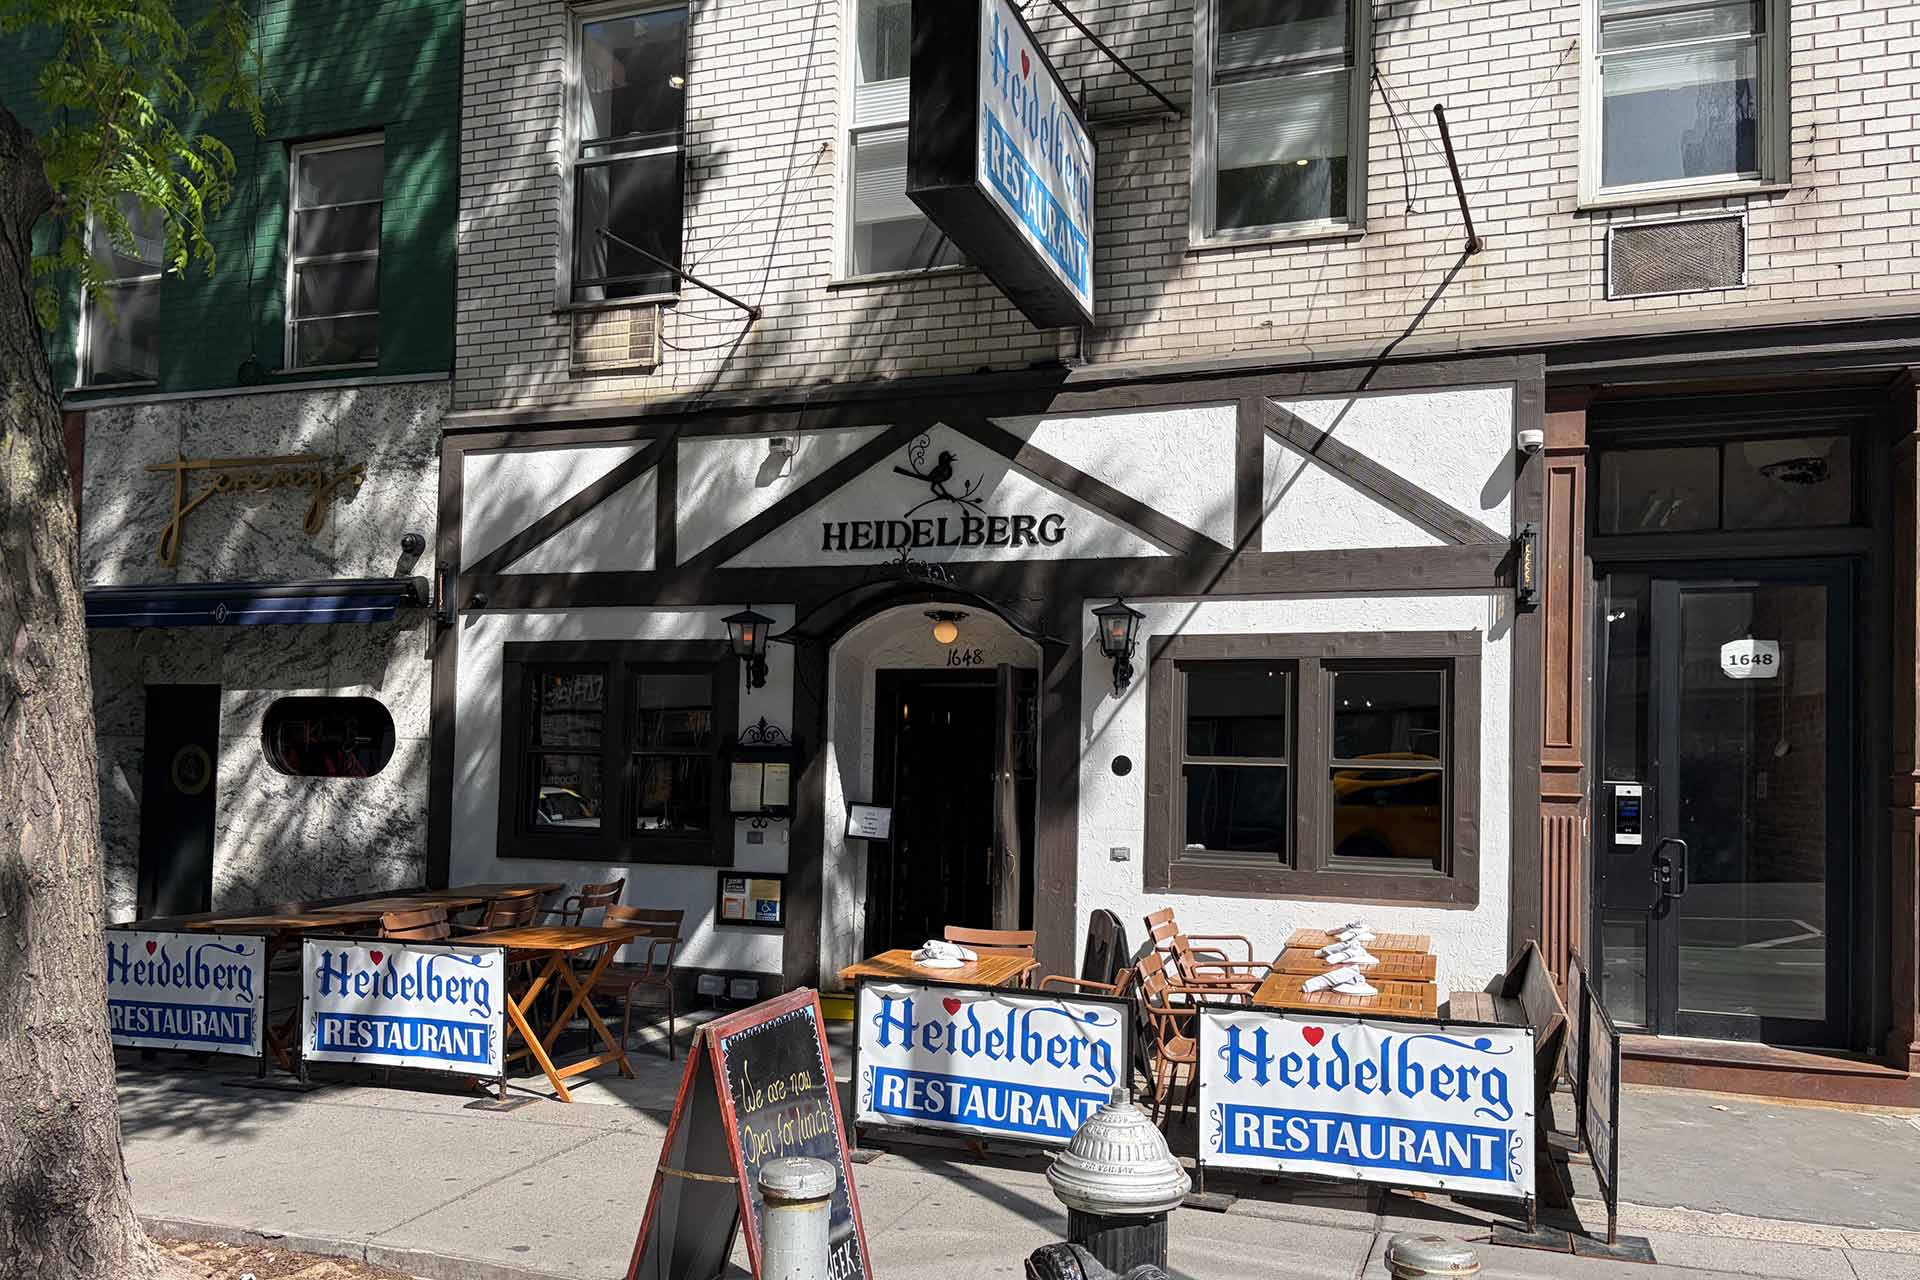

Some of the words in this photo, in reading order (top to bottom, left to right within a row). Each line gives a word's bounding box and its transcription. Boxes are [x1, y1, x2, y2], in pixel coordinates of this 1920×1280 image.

[991, 11, 1090, 236] Heidelberg
[989, 125, 1086, 277] RESTAURANT
[821, 513, 1067, 551] HEIDELBERG
[946, 648, 984, 667] 1648
[1729, 653, 1773, 666] 1648
[107, 940, 256, 1003] Heidelberg
[315, 949, 494, 1018] Heidelberg
[110, 1005, 249, 1040] RESTAURANT
[323, 1018, 485, 1057] RESTAURANT
[872, 993, 1117, 1088] Heidelberg
[741, 1059, 764, 1113] We
[767, 1080, 787, 1103] are
[790, 1069, 812, 1096] now
[1218, 1023, 1514, 1121] Heidelberg
[881, 1074, 1104, 1132] RESTAURANT
[743, 1125, 776, 1168] Open
[778, 1113, 795, 1157] for
[796, 1099, 830, 1146] lunch
[1234, 1111, 1500, 1171] RESTAURANT
